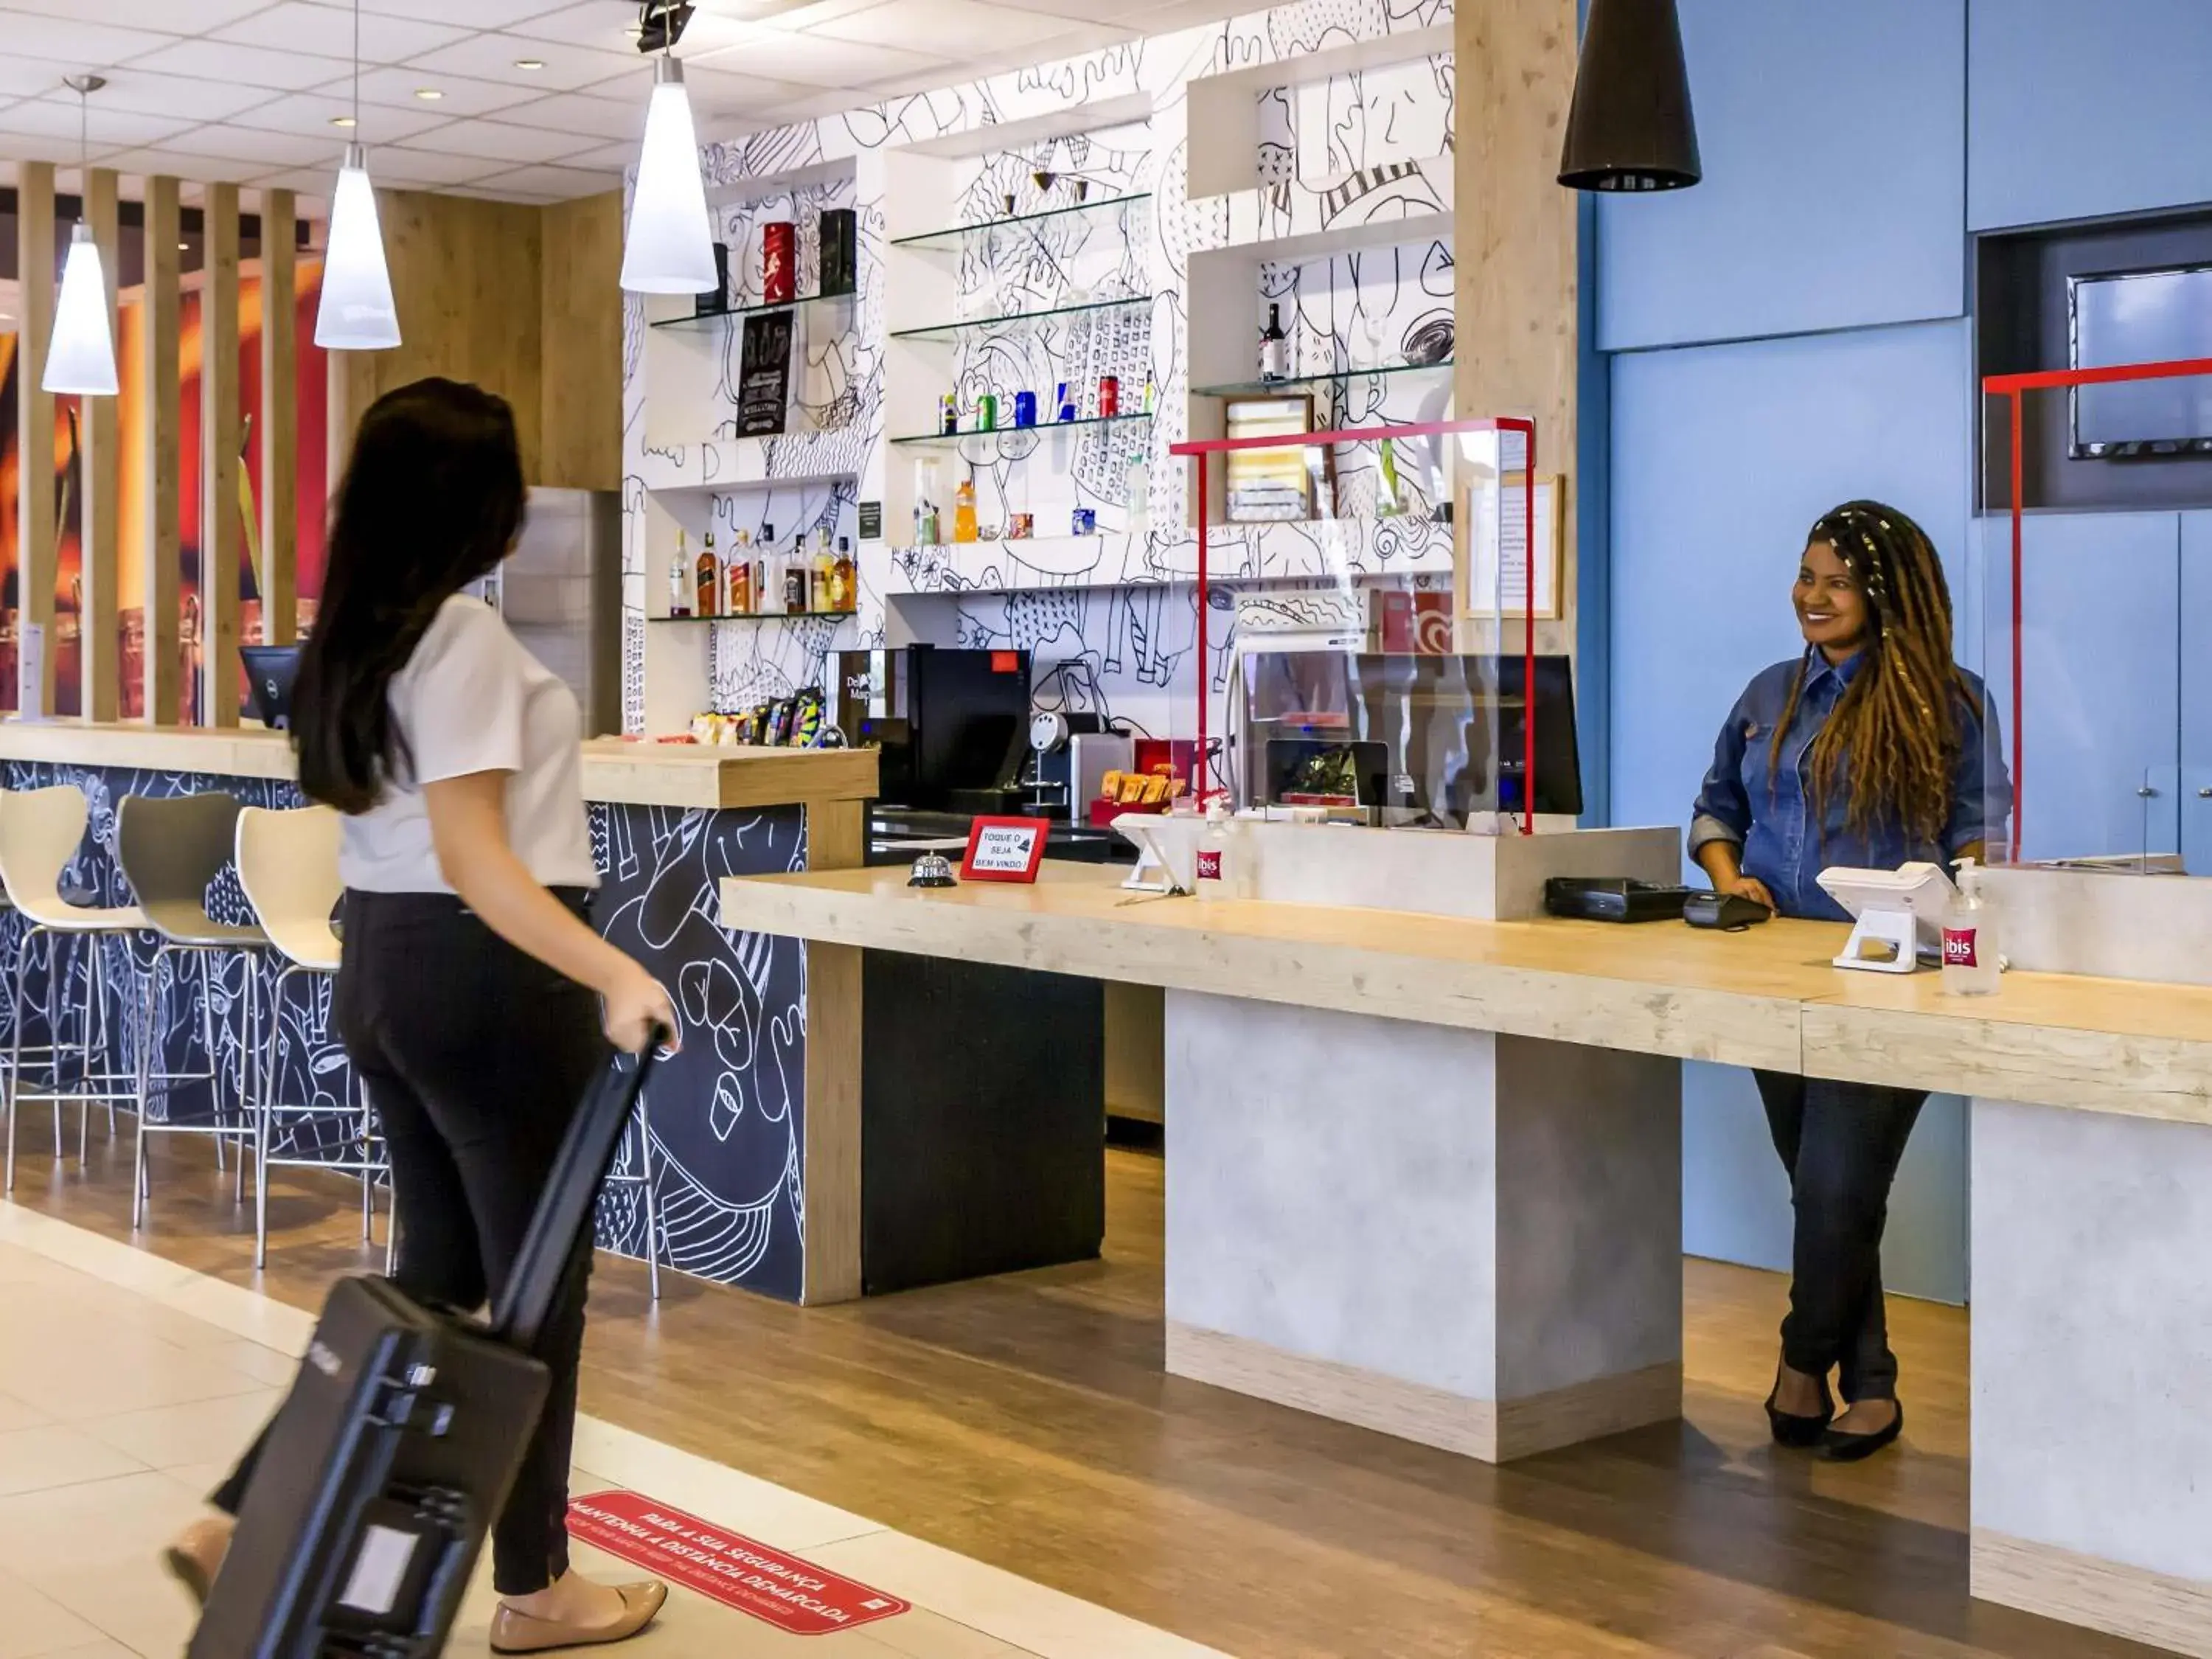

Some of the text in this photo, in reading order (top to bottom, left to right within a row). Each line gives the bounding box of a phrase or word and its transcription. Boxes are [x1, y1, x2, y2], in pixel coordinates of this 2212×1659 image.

[984, 833, 1020, 842] TOQUE O
[991, 846, 1011, 855] SEJA
[975, 858, 993, 867] BEM
[1198, 858, 1217, 871] ibis
[1946, 938, 1971, 954] ibis
[639, 1513, 826, 1591] PARA A SUA SEGURANÇA
[568, 1501, 653, 1539] MANTENHA
[646, 1536, 666, 1544] A
[740, 1575, 852, 1623] DEMARCADA
